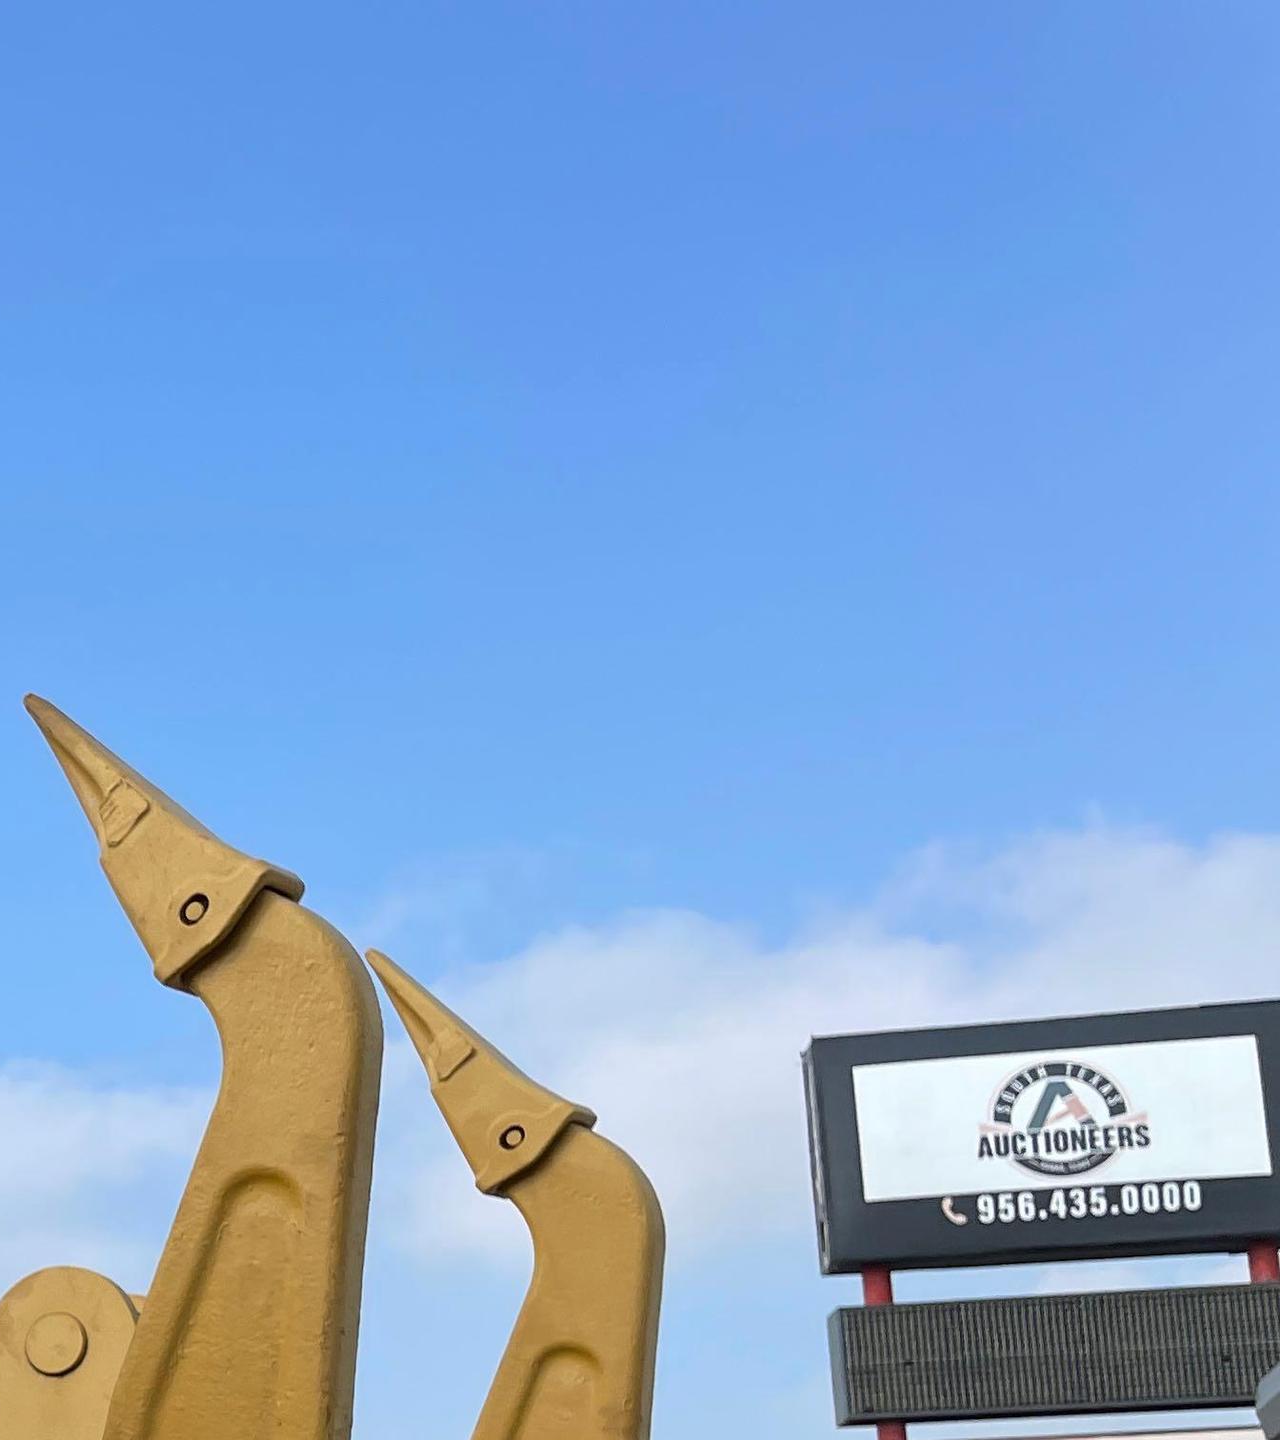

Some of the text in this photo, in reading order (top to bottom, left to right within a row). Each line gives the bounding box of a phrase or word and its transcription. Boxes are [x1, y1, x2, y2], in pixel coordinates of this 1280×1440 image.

[995, 1063, 1124, 1115] SOUTH TEXAS
[977, 1122, 1151, 1159] AUCTIONEERS
[976, 1180, 1202, 1226] 956.435.0000
